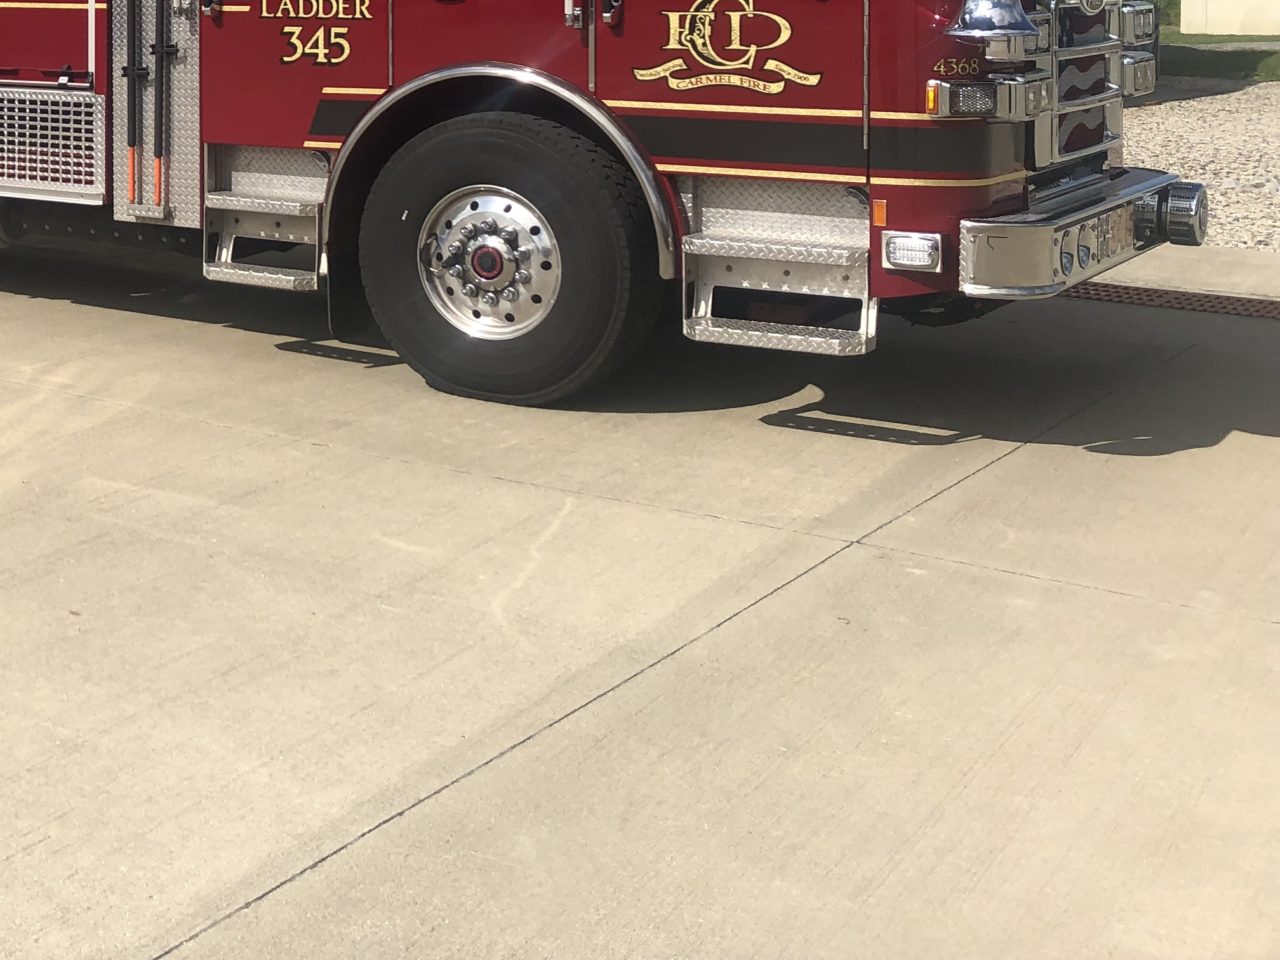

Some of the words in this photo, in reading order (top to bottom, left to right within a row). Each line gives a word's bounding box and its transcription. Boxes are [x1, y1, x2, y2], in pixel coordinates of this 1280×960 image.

[282, 25, 351, 63] 345
[933, 57, 980, 76] 4368
[675, 75, 736, 90] CARMEL
[739, 77, 772, 93] FIRE
